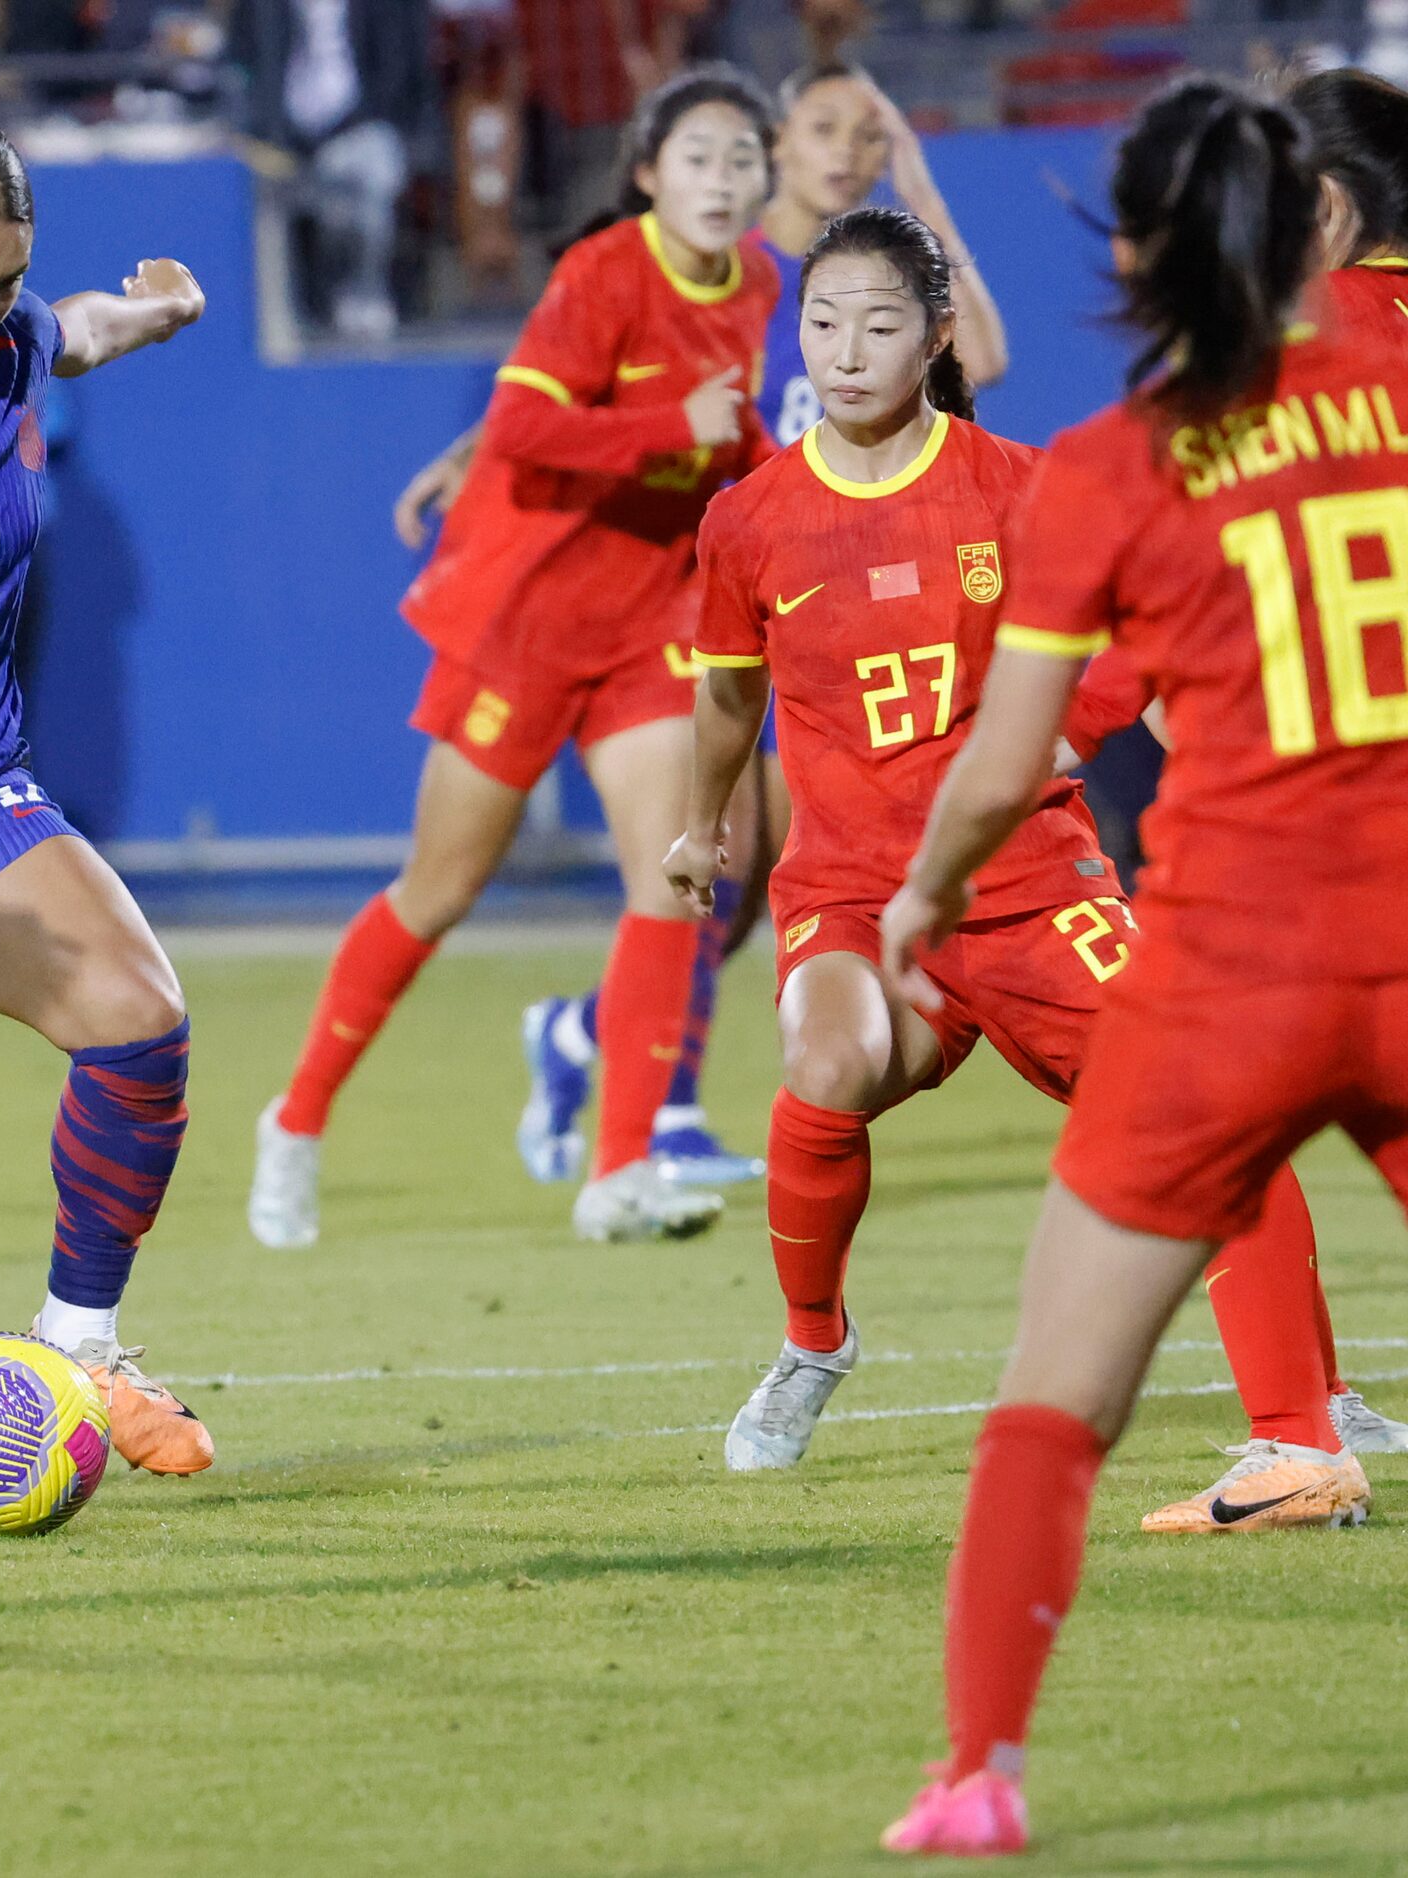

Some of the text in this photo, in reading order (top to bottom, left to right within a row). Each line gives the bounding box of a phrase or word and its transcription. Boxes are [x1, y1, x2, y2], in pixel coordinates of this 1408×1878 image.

[960, 546, 995, 561] CFA
[1219, 486, 1408, 755] 18
[854, 642, 956, 749] 27
